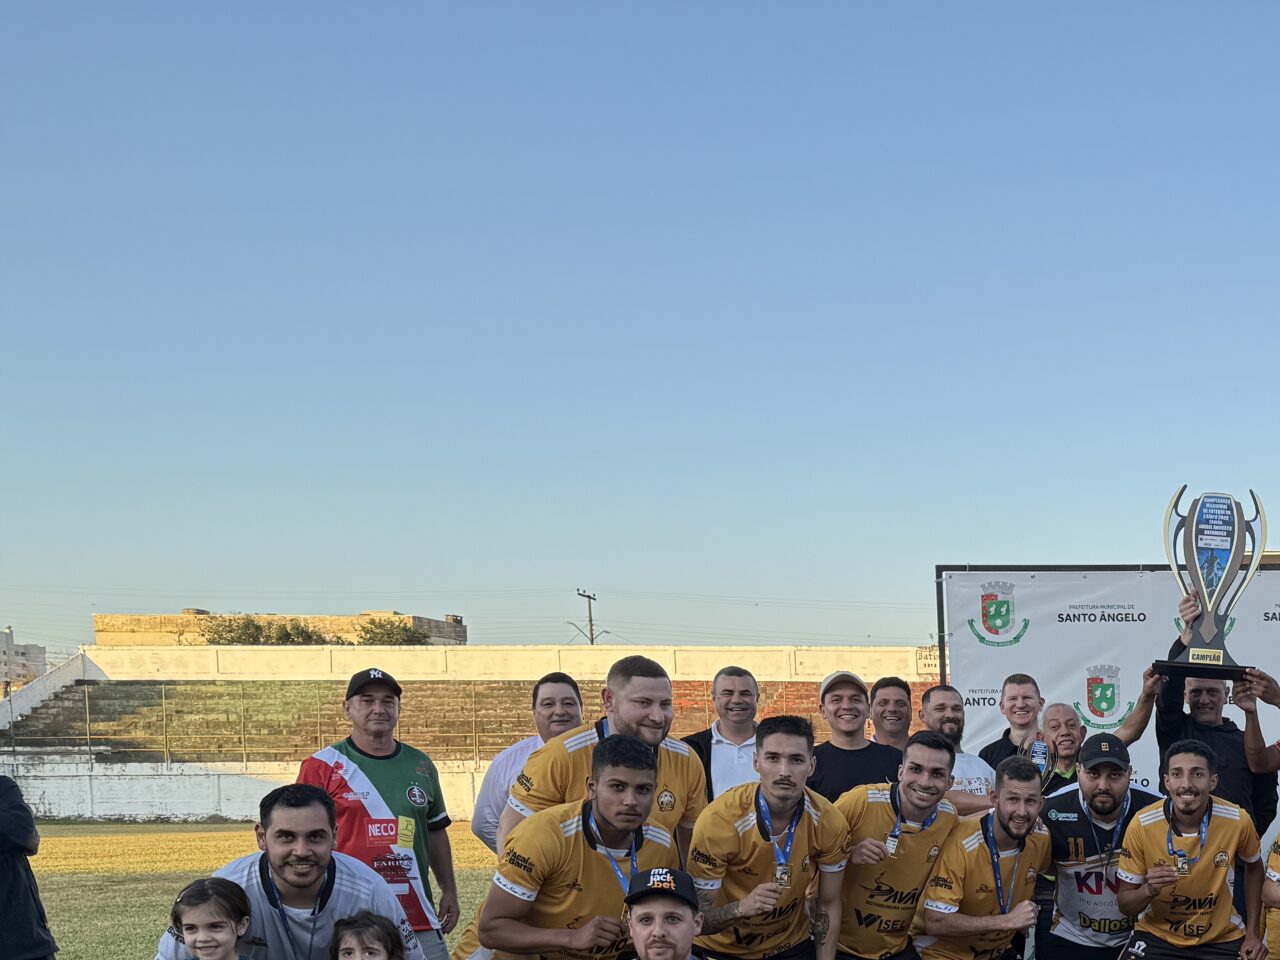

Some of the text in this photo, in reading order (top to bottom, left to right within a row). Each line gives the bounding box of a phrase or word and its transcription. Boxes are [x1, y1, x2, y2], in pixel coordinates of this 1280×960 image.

[1057, 610, 1147, 623] SANTO ÂNGELO
[1191, 653, 1221, 662] CAMPEÃO
[964, 697, 996, 707] ANTO
[368, 823, 396, 837] NECO
[1067, 837, 1086, 863] 11
[651, 868, 669, 876] mr
[649, 872, 674, 886] jack
